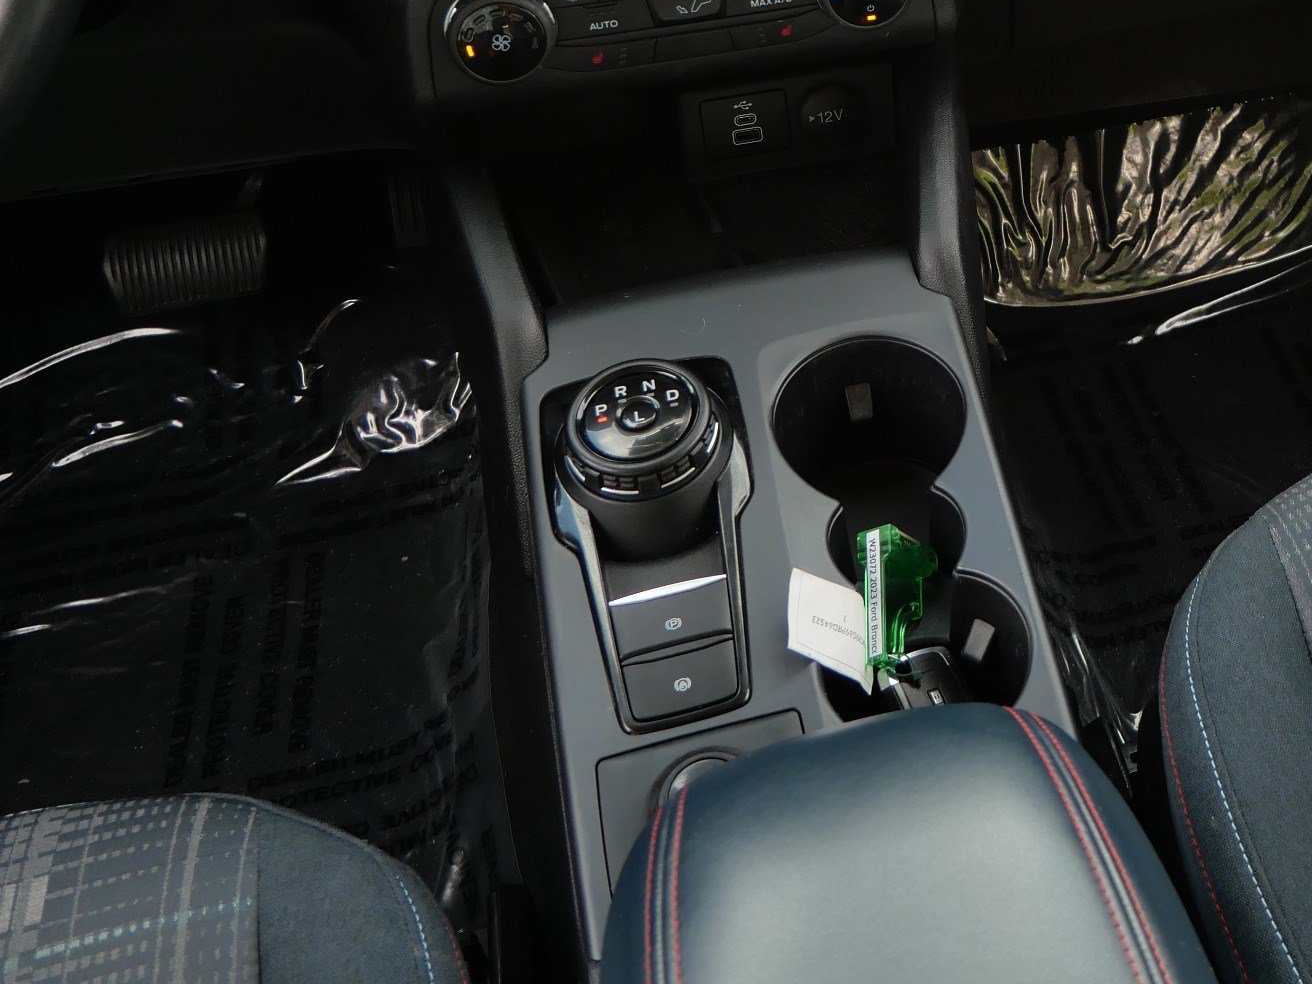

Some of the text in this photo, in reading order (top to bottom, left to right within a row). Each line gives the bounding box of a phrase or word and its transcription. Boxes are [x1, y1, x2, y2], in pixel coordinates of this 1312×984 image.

[589, 19, 619, 31] AUTO
[817, 108, 844, 123] 12V
[614, 385, 627, 398] R
[642, 379, 656, 392] N
[666, 389, 680, 401] D
[594, 404, 608, 416] P
[634, 411, 645, 422] L
[869, 538, 877, 575] W23072
[870, 577, 878, 599] 2023
